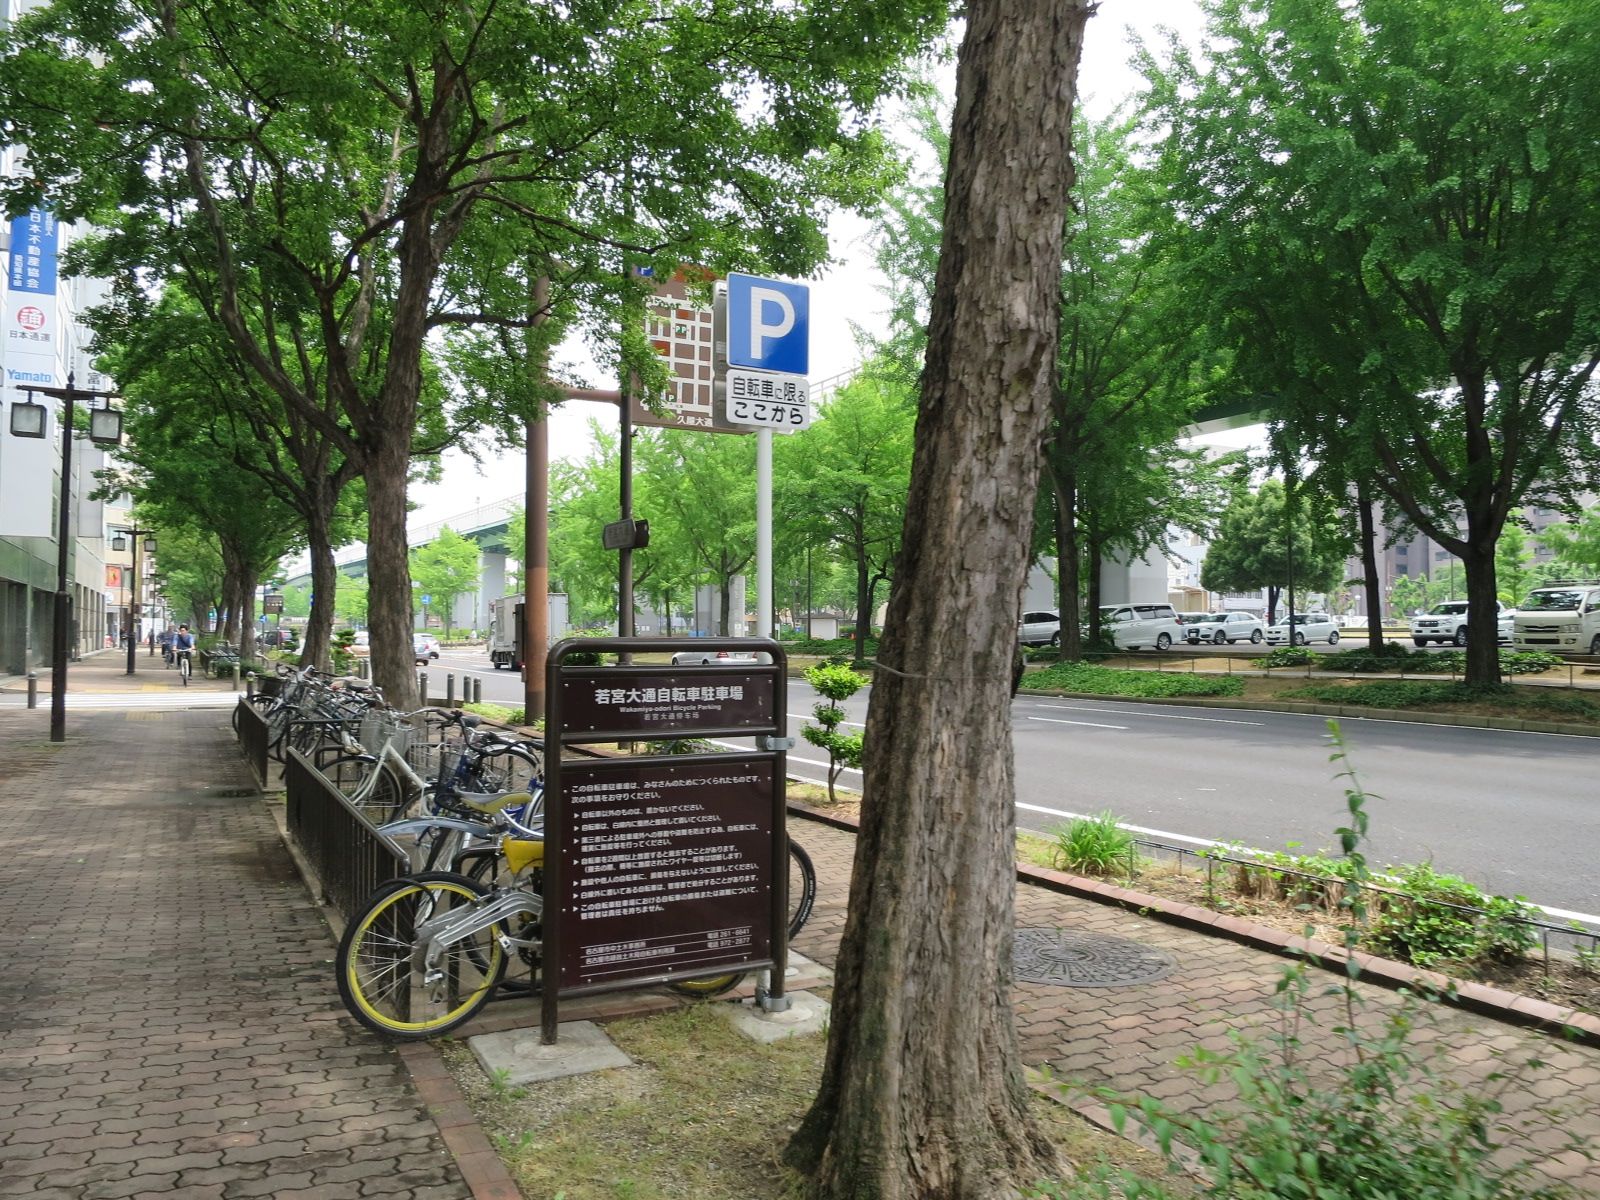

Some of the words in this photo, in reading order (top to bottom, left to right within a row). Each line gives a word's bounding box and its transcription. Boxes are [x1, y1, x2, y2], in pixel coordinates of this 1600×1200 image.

[750, 286, 796, 360] P
[9, 330, 51, 341] 日本通運
[7, 368, 52, 383] Yamato
[733, 376, 806, 402] 自転車に限る
[734, 401, 804, 424] ここから
[595, 685, 743, 704] 若宮大通自転車駐車場
